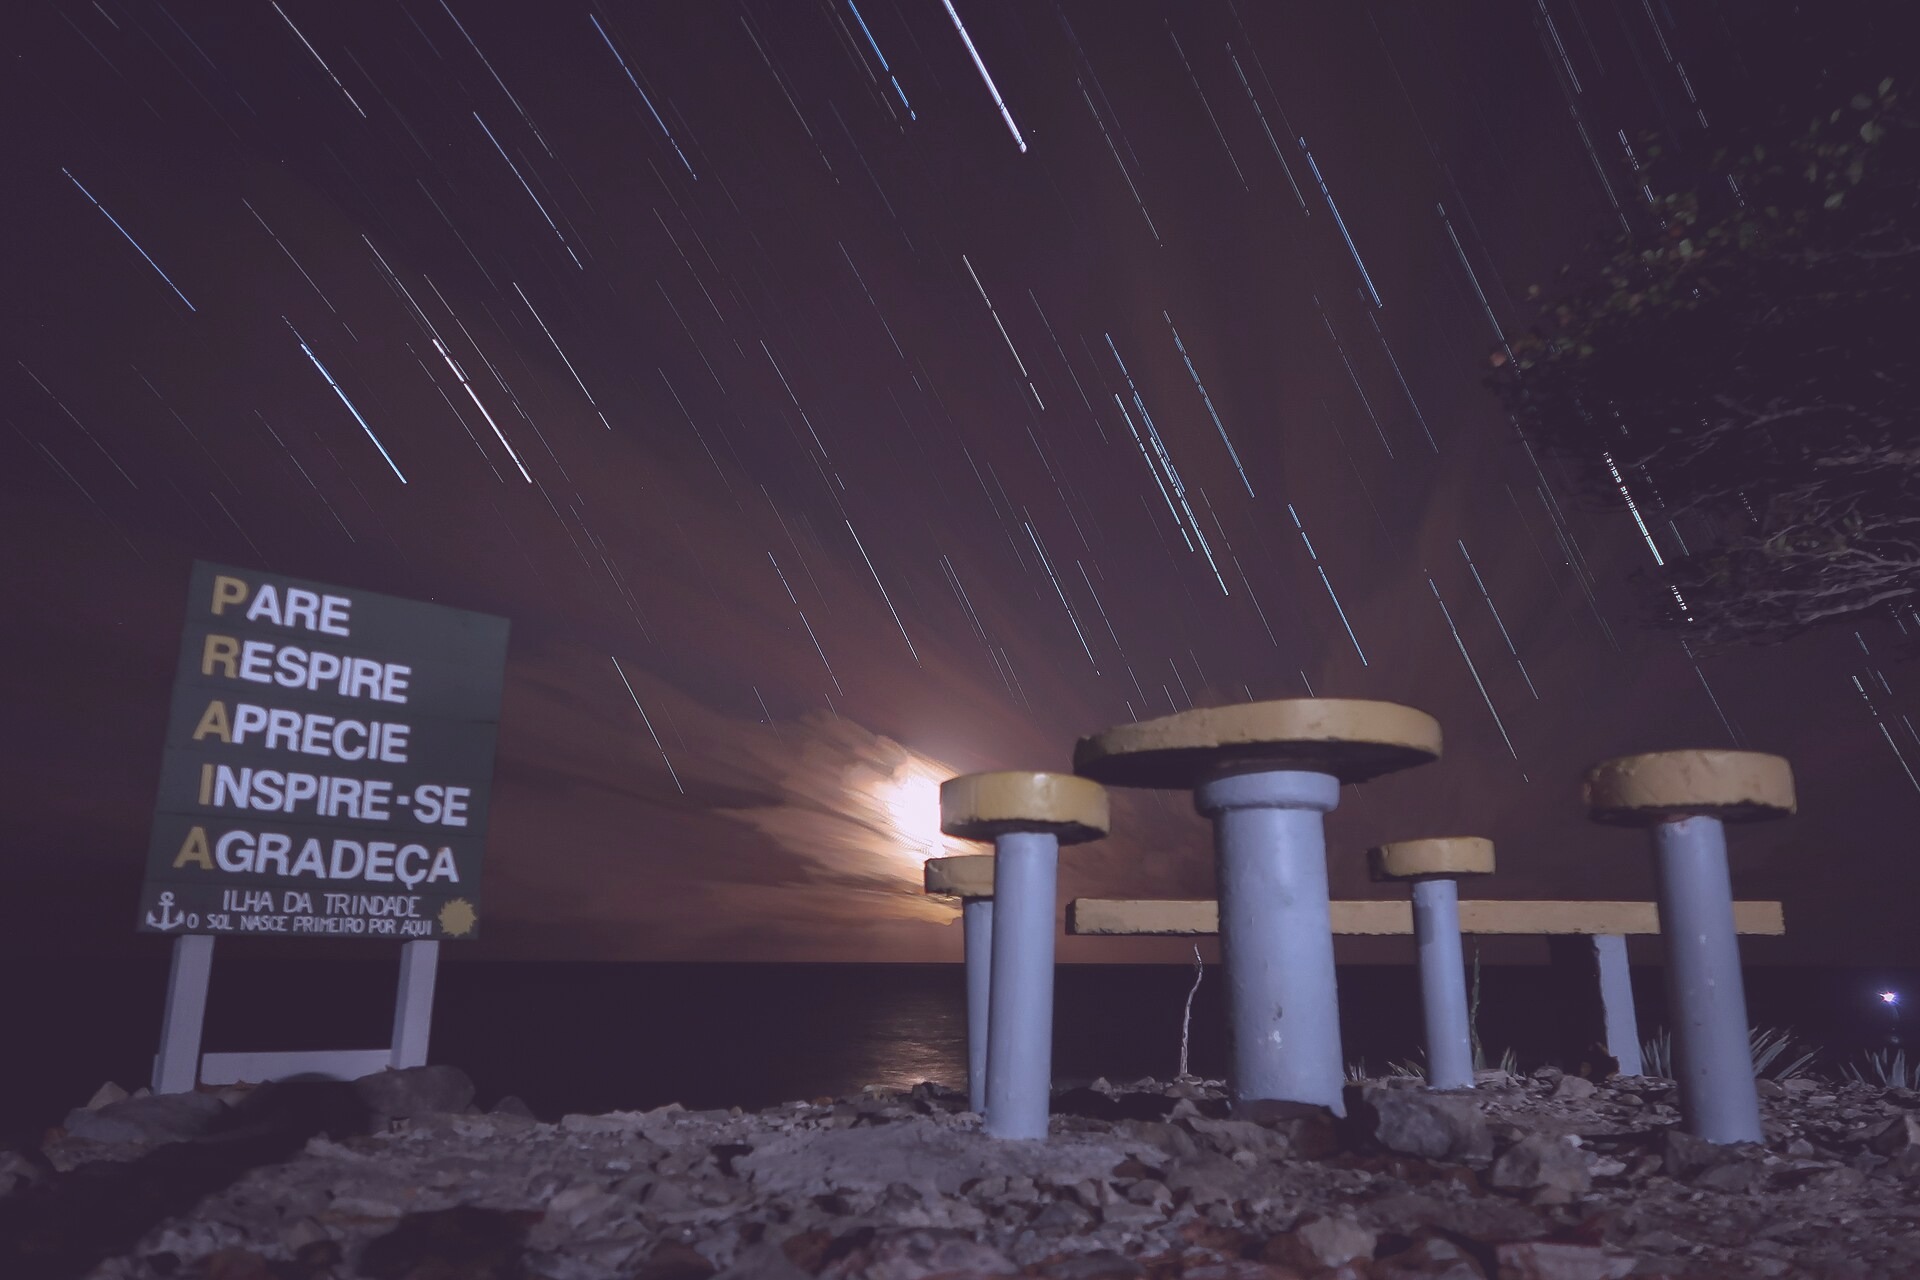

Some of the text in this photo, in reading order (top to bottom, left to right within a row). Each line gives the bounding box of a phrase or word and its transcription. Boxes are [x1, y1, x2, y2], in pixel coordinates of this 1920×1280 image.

[210, 575, 352, 637] PARE
[201, 633, 412, 703] RESPIRE
[192, 700, 411, 763] APRECIE
[198, 763, 470, 827] INSPIRE-SE
[172, 826, 460, 890] AGRADEÇA
[186, 914, 432, 937] O SOL NASCE PRIMEIRO POR AQUI
[222, 889, 421, 918] ILHA DA TRINDADE
